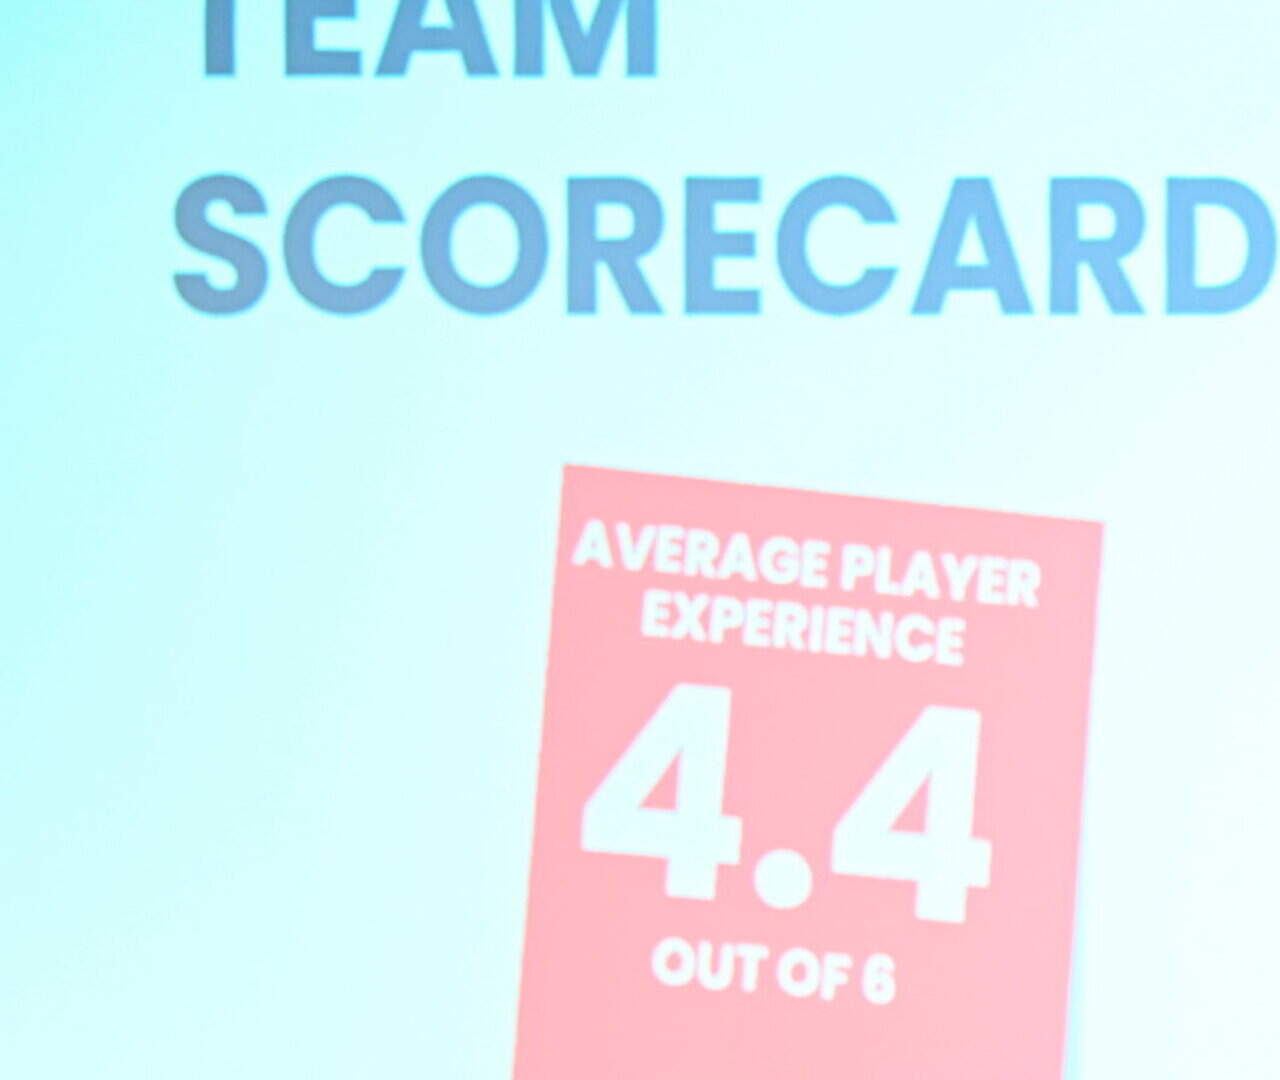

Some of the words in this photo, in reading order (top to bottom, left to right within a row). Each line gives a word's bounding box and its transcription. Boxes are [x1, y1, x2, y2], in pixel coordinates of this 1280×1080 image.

[573, 520, 830, 588] AVERAGE
[839, 545, 1041, 609] PLAYER
[643, 592, 966, 666] EXPERIENCE
[582, 684, 992, 923] 4.4
[652, 937, 770, 992] OUT
[778, 949, 852, 1000] OF
[863, 954, 895, 1004] 6
